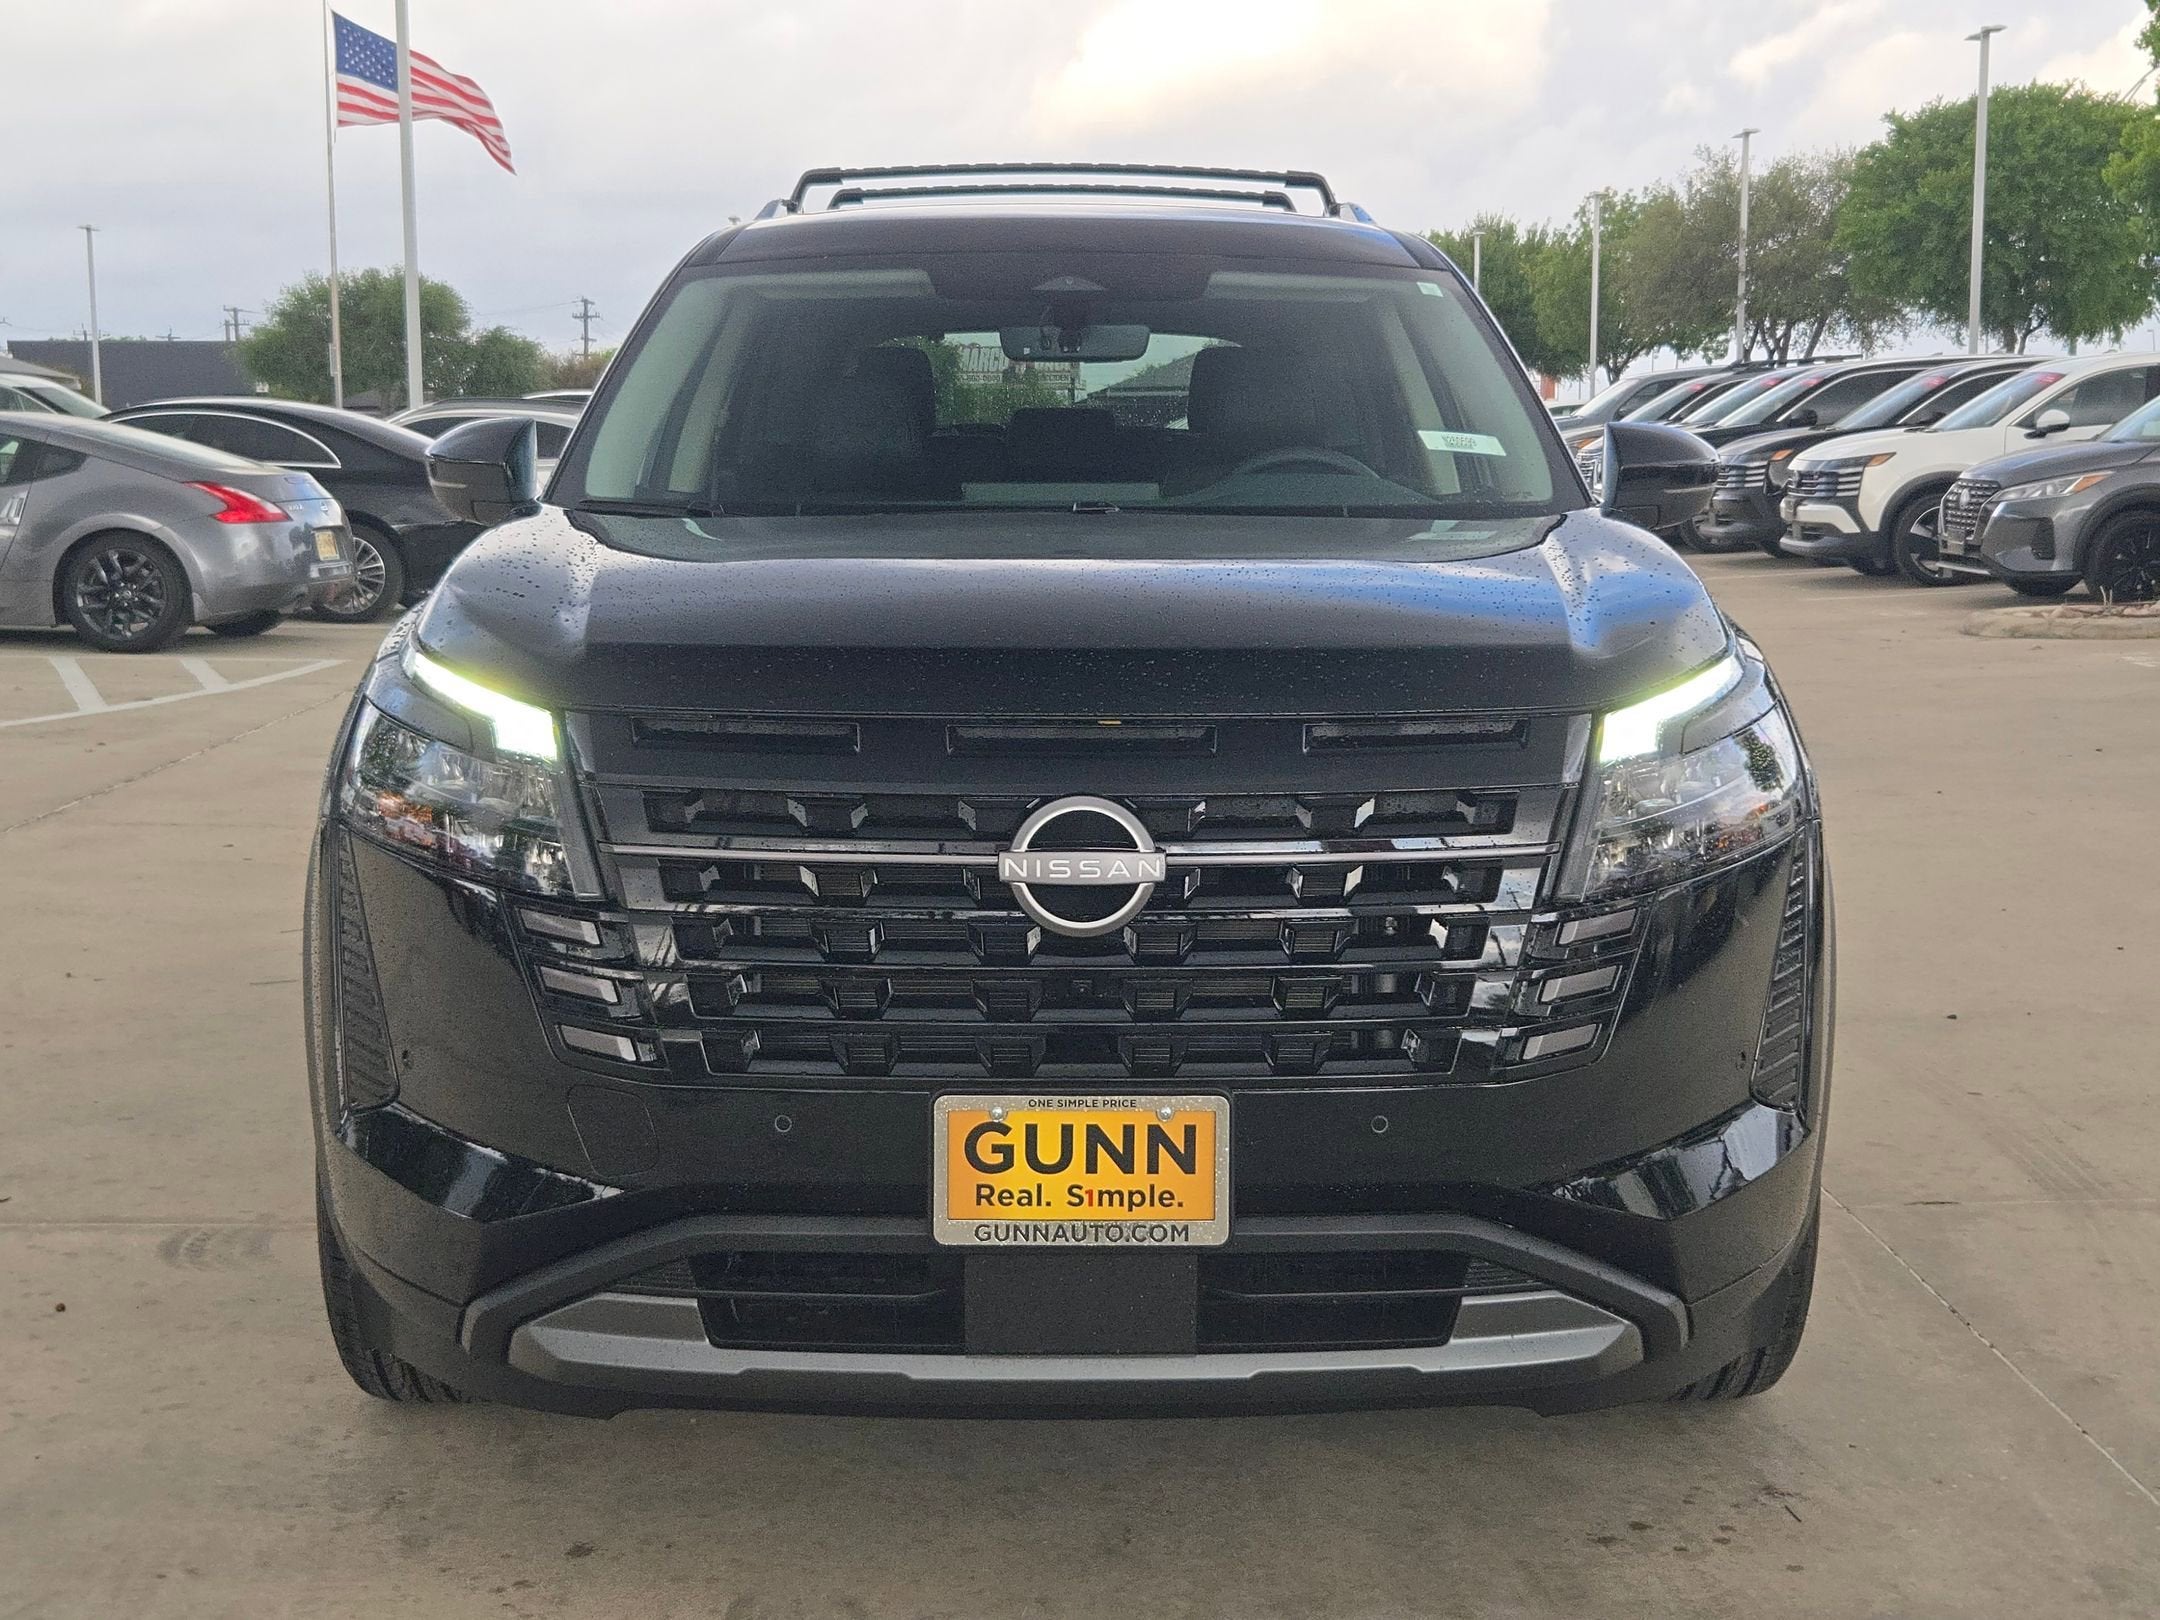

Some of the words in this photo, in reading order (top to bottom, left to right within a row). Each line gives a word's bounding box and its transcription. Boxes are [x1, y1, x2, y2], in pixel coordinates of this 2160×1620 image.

[1004, 858, 1161, 878] NISSAN
[1028, 1099, 1053, 1108] ONE
[1057, 1099, 1099, 1108] SIMPLE
[1102, 1099, 1137, 1108] PRICE
[964, 1121, 1196, 1175] GUNN
[975, 1183, 1052, 1207] Real.
[974, 1223, 1190, 1243] GUNNAUTO.COM
